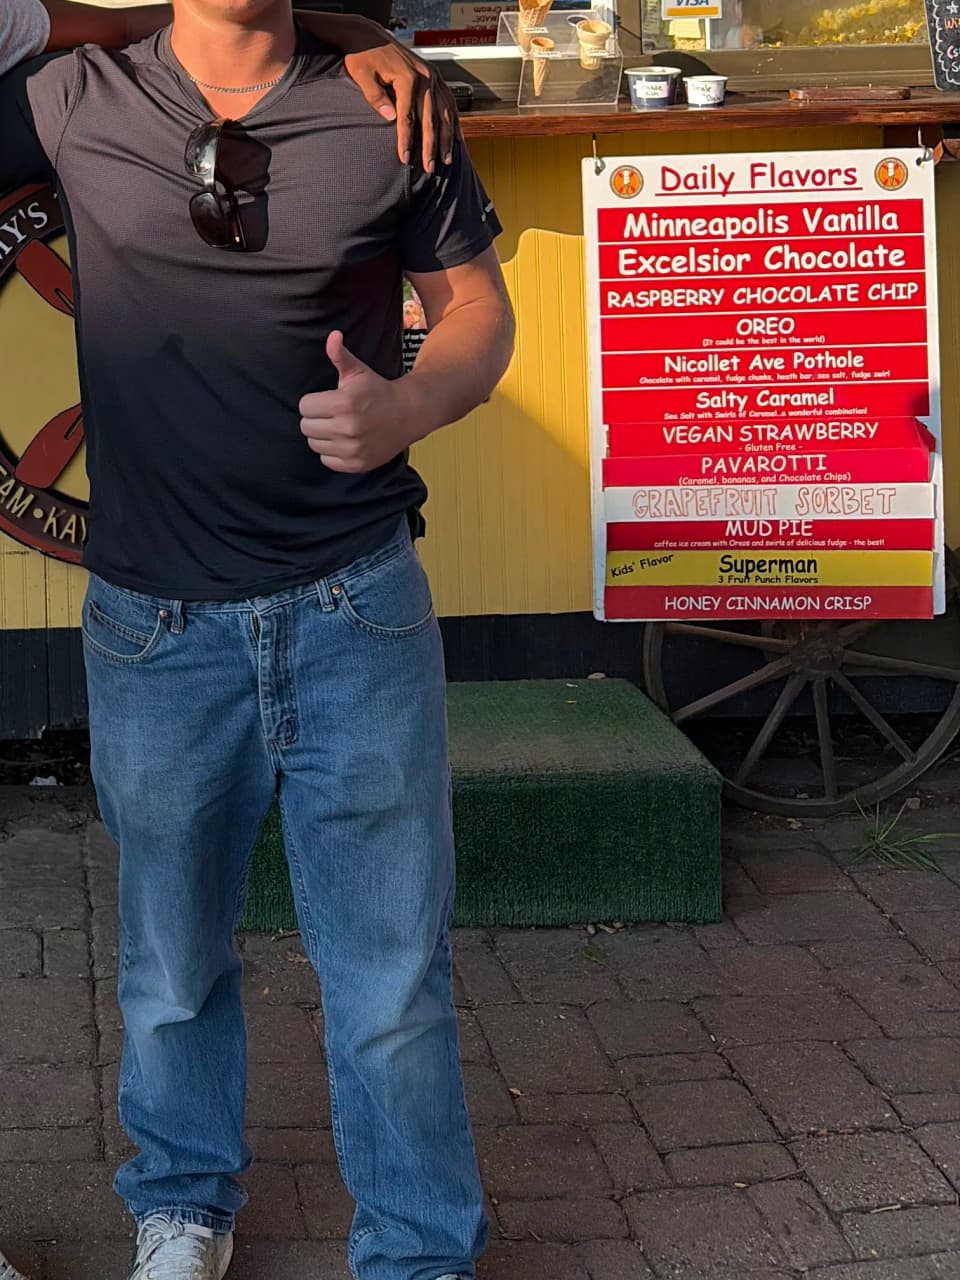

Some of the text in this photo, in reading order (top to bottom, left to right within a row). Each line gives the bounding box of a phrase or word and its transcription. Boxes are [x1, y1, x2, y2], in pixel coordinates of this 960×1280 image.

[660, 162, 858, 196] Daily Flavors
[623, 205, 899, 240] Minneapolis Vanilla
[618, 242, 906, 276] Excelsior Chocolate
[607, 282, 919, 308] RASPBERRY CHOCOLATE CHIP
[736, 317, 795, 336] OREO
[736, 337, 745, 345] be
[762, 336, 778, 344] best
[789, 335, 800, 343] the
[803, 335, 825, 343] world)
[664, 350, 864, 373] Nicollet Ave Pothole
[696, 387, 834, 412] Salty Caramel
[662, 422, 879, 444] VEGAN STRAWBERRY
[744, 442, 796, 452] Gluten Free
[701, 454, 827, 474] PAVAROTTI
[760, 474, 777, 482] and
[779, 473, 821, 482] Chocolate
[823, 472, 851, 482] Chips)
[632, 487, 897, 518] GRAPEFRUIT SORBET
[725, 520, 813, 537] MUD PIE
[653, 540, 677, 548] coffee
[796, 539, 826, 547] delicious
[827, 539, 847, 548] fudge
[854, 538, 866, 546] the
[611, 554, 675, 578] Kids' Flavor
[718, 554, 818, 578] Superman
[755, 575, 781, 583] Punch
[785, 575, 818, 583] Flavors
[665, 596, 872, 610] HONEY CINNAMON CRISP
